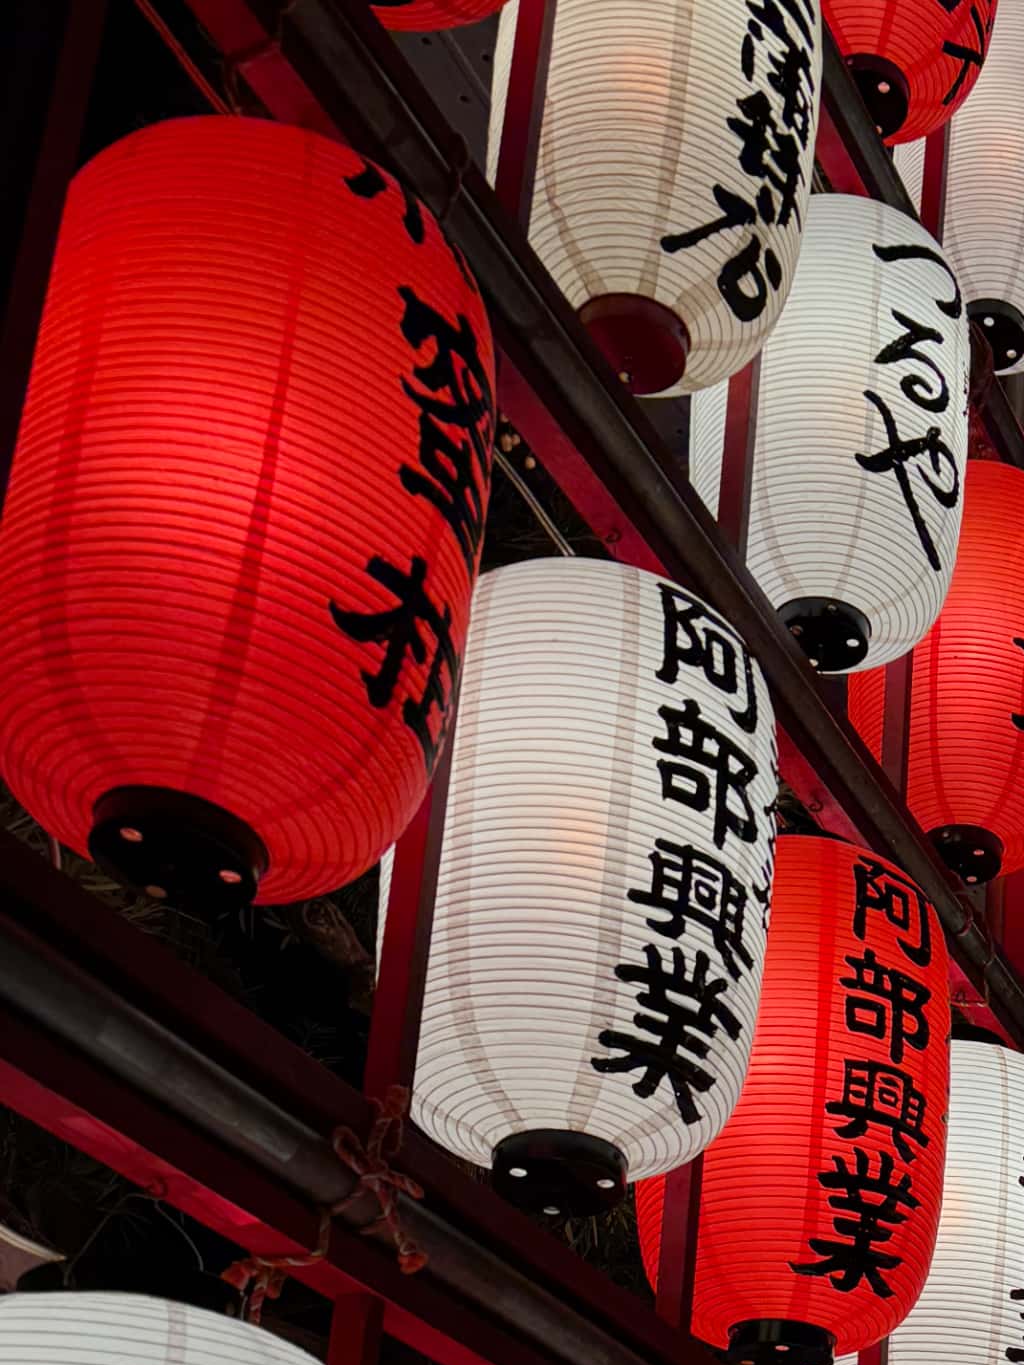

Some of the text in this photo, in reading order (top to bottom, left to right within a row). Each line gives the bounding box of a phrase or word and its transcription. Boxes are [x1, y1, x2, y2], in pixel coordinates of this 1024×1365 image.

[854, 244, 963, 571] つるや
[590, 581, 761, 1127] 阿部興業
[787, 856, 932, 1301] 阿部興業
